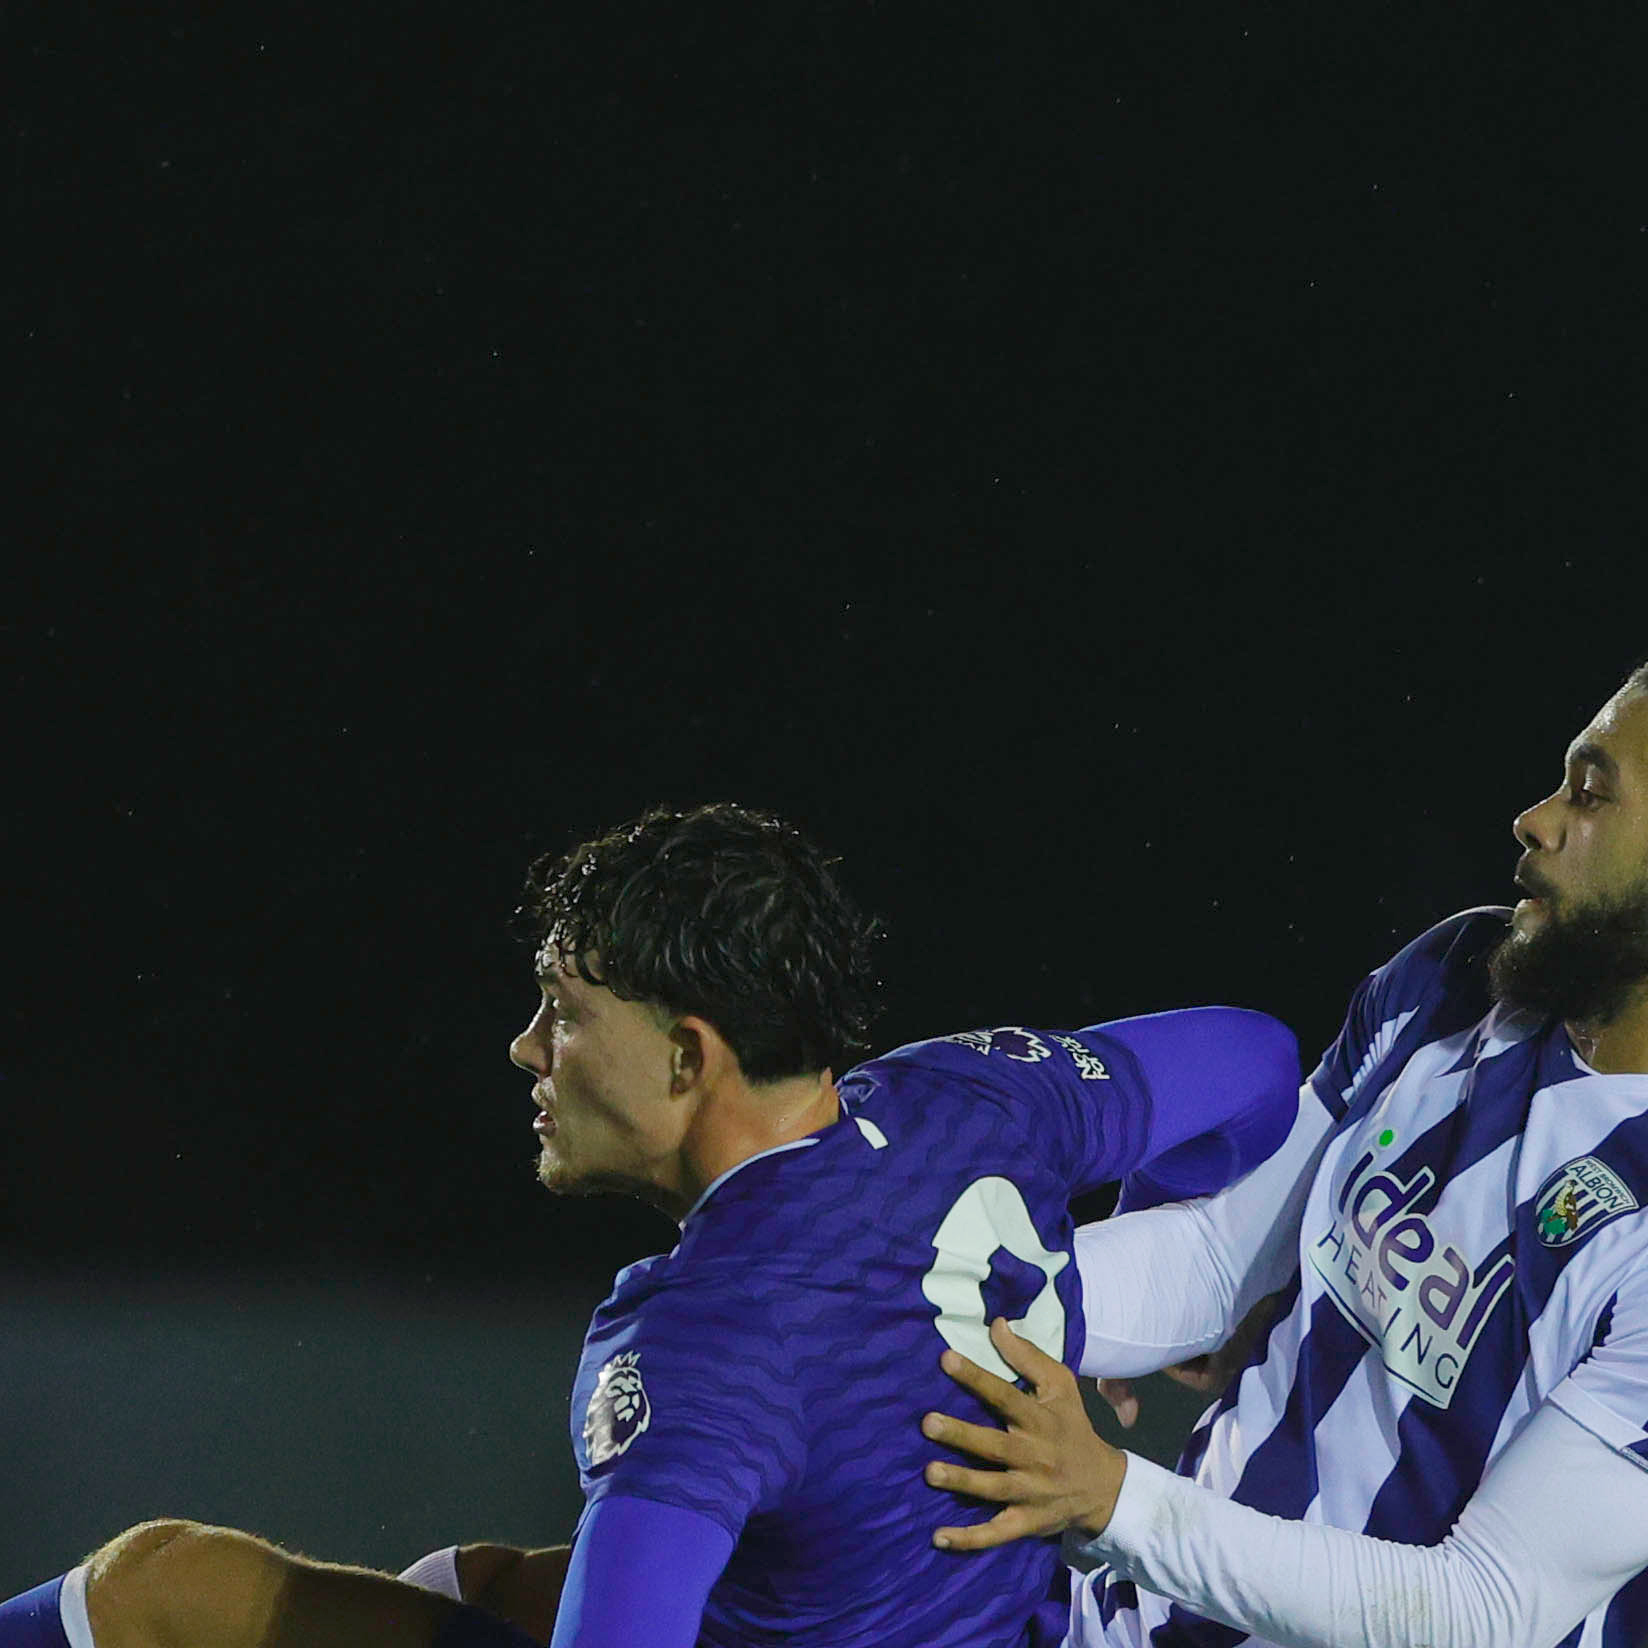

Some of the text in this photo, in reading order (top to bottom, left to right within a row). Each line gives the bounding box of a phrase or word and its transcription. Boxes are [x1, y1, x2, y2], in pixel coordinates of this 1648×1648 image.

[1339, 1129, 1514, 1350] ideal
[1569, 1164, 1623, 1209] ALBION
[1317, 1221, 1458, 1388] HEATING
